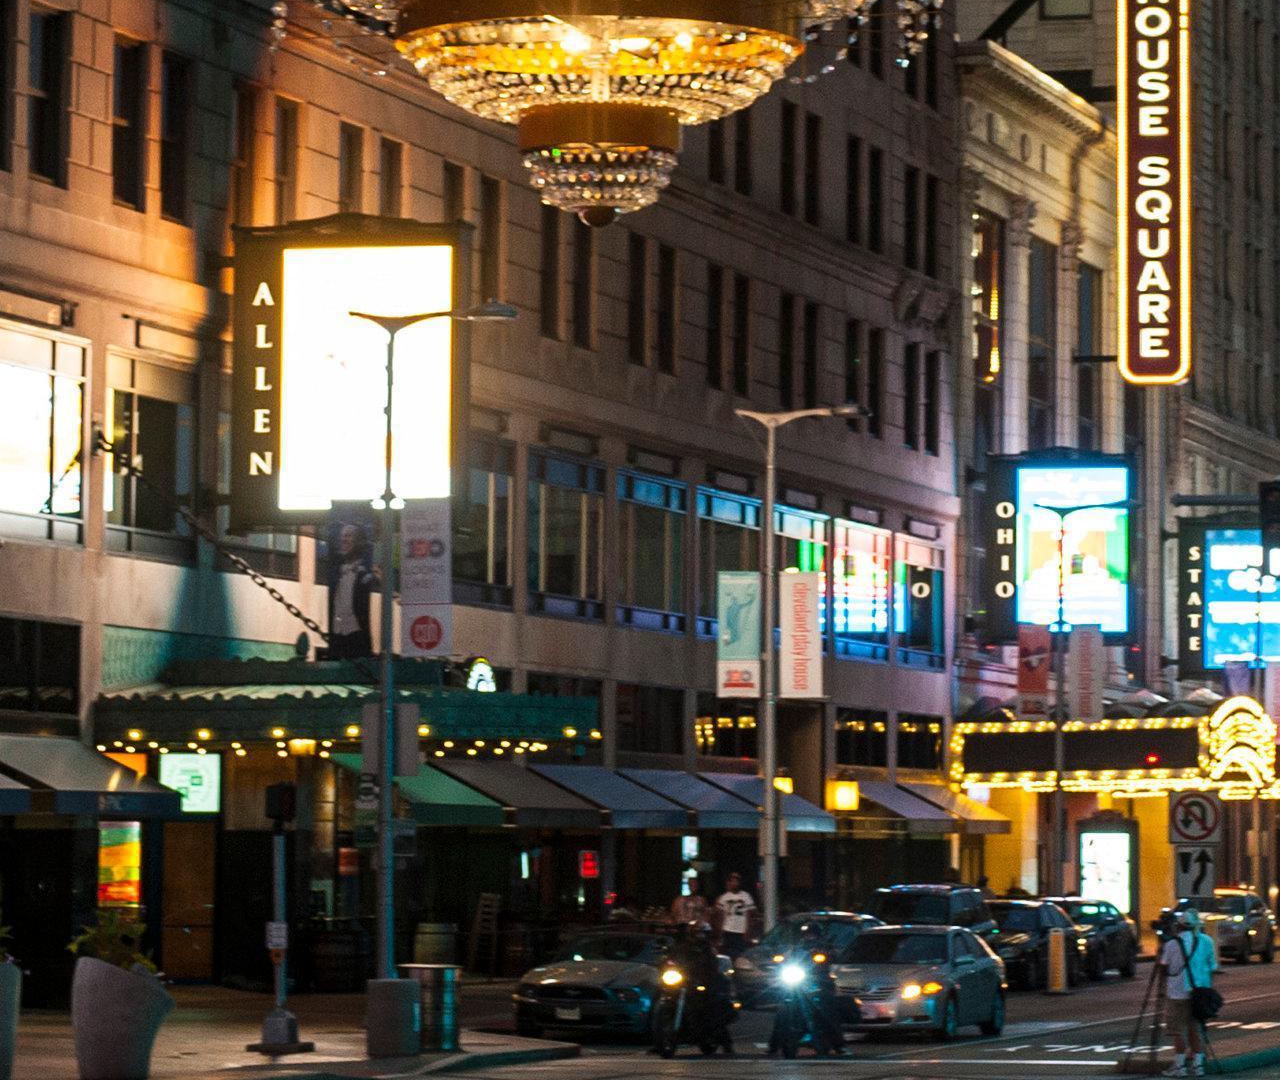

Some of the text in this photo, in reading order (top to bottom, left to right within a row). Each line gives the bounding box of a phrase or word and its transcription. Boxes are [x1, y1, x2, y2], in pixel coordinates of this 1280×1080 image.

[1135, 155, 1172, 359] SQUARE
[248, 281, 275, 476] ALLEN
[994, 501, 1016, 599] OHIO
[1186, 545, 1202, 652] STATE
